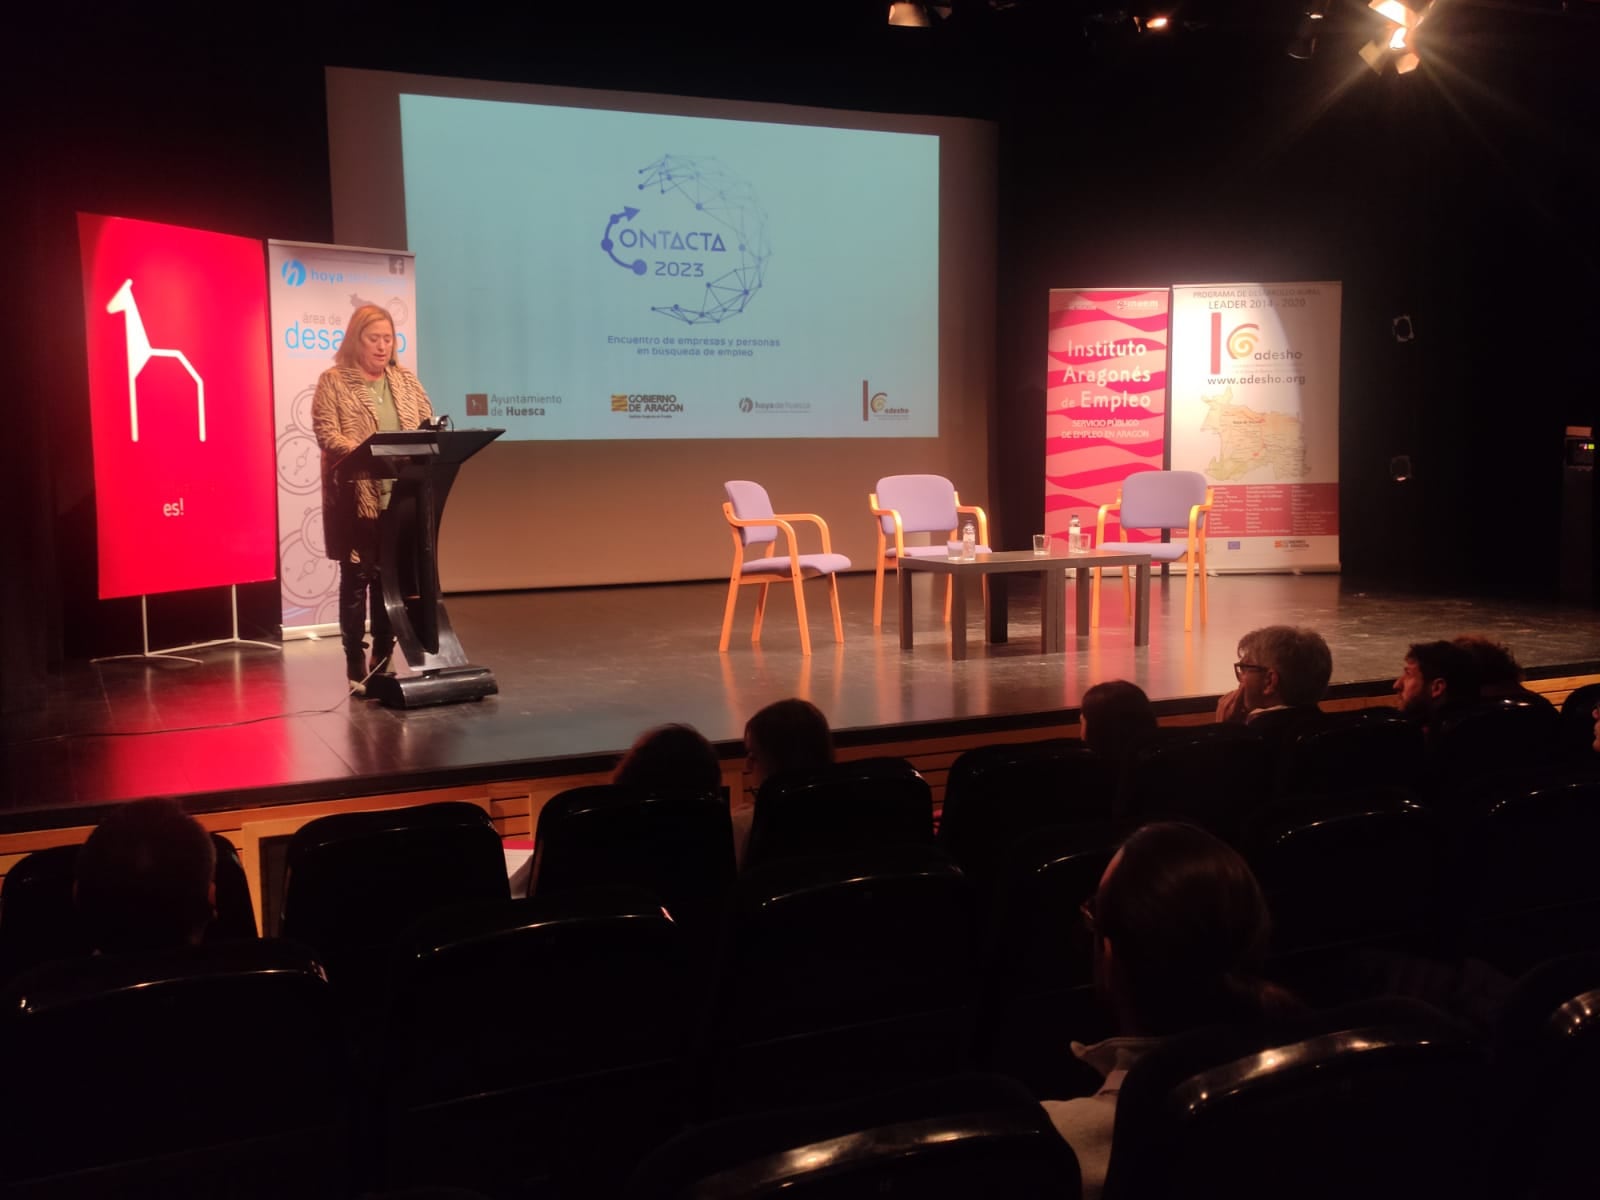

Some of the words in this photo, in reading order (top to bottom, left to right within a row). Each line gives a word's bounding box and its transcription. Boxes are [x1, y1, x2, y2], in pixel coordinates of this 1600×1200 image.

[655, 261, 704, 277] 2023
[311, 269, 344, 285] hoya
[1193, 290, 1236, 299] PROGRAMA
[1237, 289, 1247, 297] DE
[1208, 299, 1247, 310] LEADER
[1250, 299, 1272, 309] 2014
[328, 314, 342, 325] de
[607, 335, 660, 345] Encuentro
[662, 336, 675, 345] de
[678, 337, 726, 347] empresas
[735, 338, 780, 348] personas
[637, 347, 650, 355] en
[703, 348, 715, 356] de
[718, 348, 753, 358] empleo
[1068, 340, 1147, 357] Instituto
[1254, 350, 1303, 361] adesho
[1062, 366, 1151, 387] Aragonés
[1207, 374, 1306, 385] www.adesho.org
[490, 393, 562, 405] Ayuntamiento
[628, 394, 677, 403] GOBIERNO
[1061, 398, 1075, 408] de
[1081, 391, 1151, 412] Empleo
[491, 407, 503, 416] de
[506, 407, 545, 416] Huesca
[629, 404, 641, 412] DE
[1071, 419, 1106, 428] SERVICIO
[1061, 430, 1072, 438] DE
[1073, 430, 1104, 438] EMPLEO
[163, 498, 185, 517] es!
